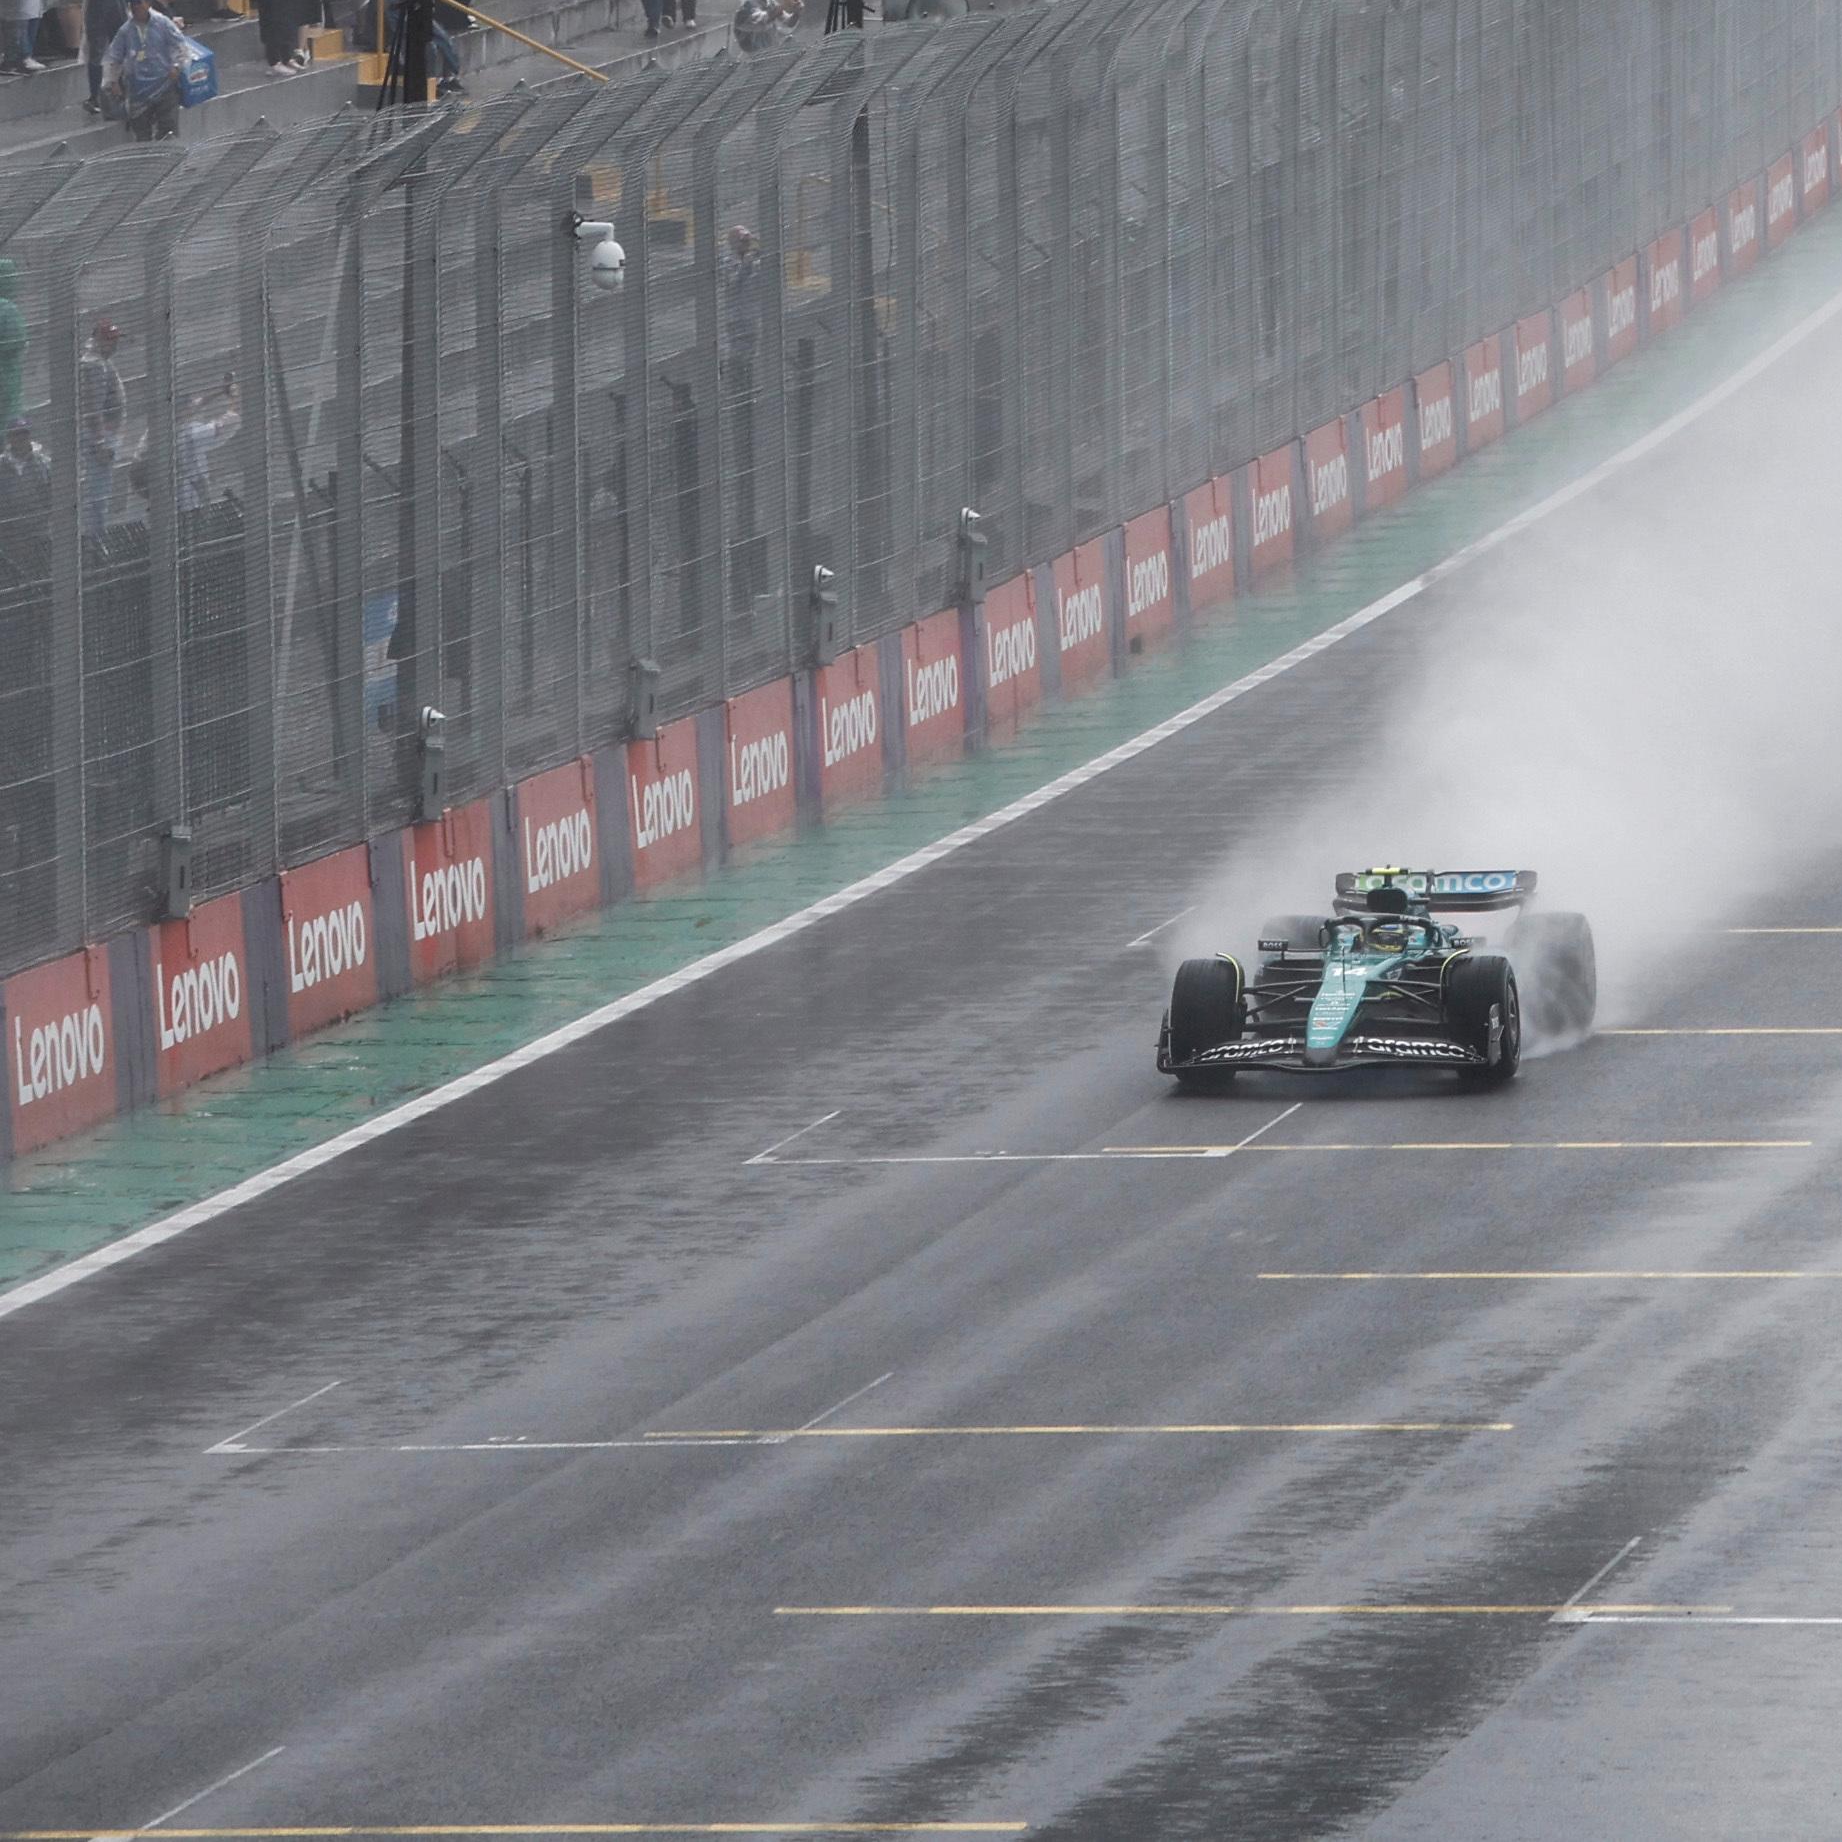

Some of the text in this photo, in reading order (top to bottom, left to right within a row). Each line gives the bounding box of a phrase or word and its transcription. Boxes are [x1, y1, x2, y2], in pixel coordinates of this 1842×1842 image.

[1517, 342, 1546, 395] Lenovo
[1565, 316, 1591, 368] Lenovo
[1419, 397, 1450, 451] Lenovo
[1469, 369, 1498, 422] Lenovo
[1310, 454, 1346, 513] Lenovo
[1367, 423, 1401, 480] Lenovo
[1190, 515, 1229, 577] Lenovo
[1252, 485, 1290, 544] Lenovo
[1127, 550, 1168, 614] Lenovo
[1060, 585, 1101, 649] Lenovo
[987, 615, 1035, 687] Lenovo
[908, 652, 959, 726] Lenovo
[823, 690, 876, 767] Lenovo
[732, 729, 788, 805] Lenovo
[632, 767, 693, 849] Lenovo
[525, 810, 591, 893] Lenovo
[411, 856, 485, 940] Lenovo
[289, 900, 366, 992] Lenovo
[1263, 941, 1283, 949] BOSS
[1331, 967, 1367, 977] 14
[158, 950, 240, 1051] Lenovo
[14, 1005, 104, 1105] Lenovo
[1367, 1038, 1465, 1058] aramco
